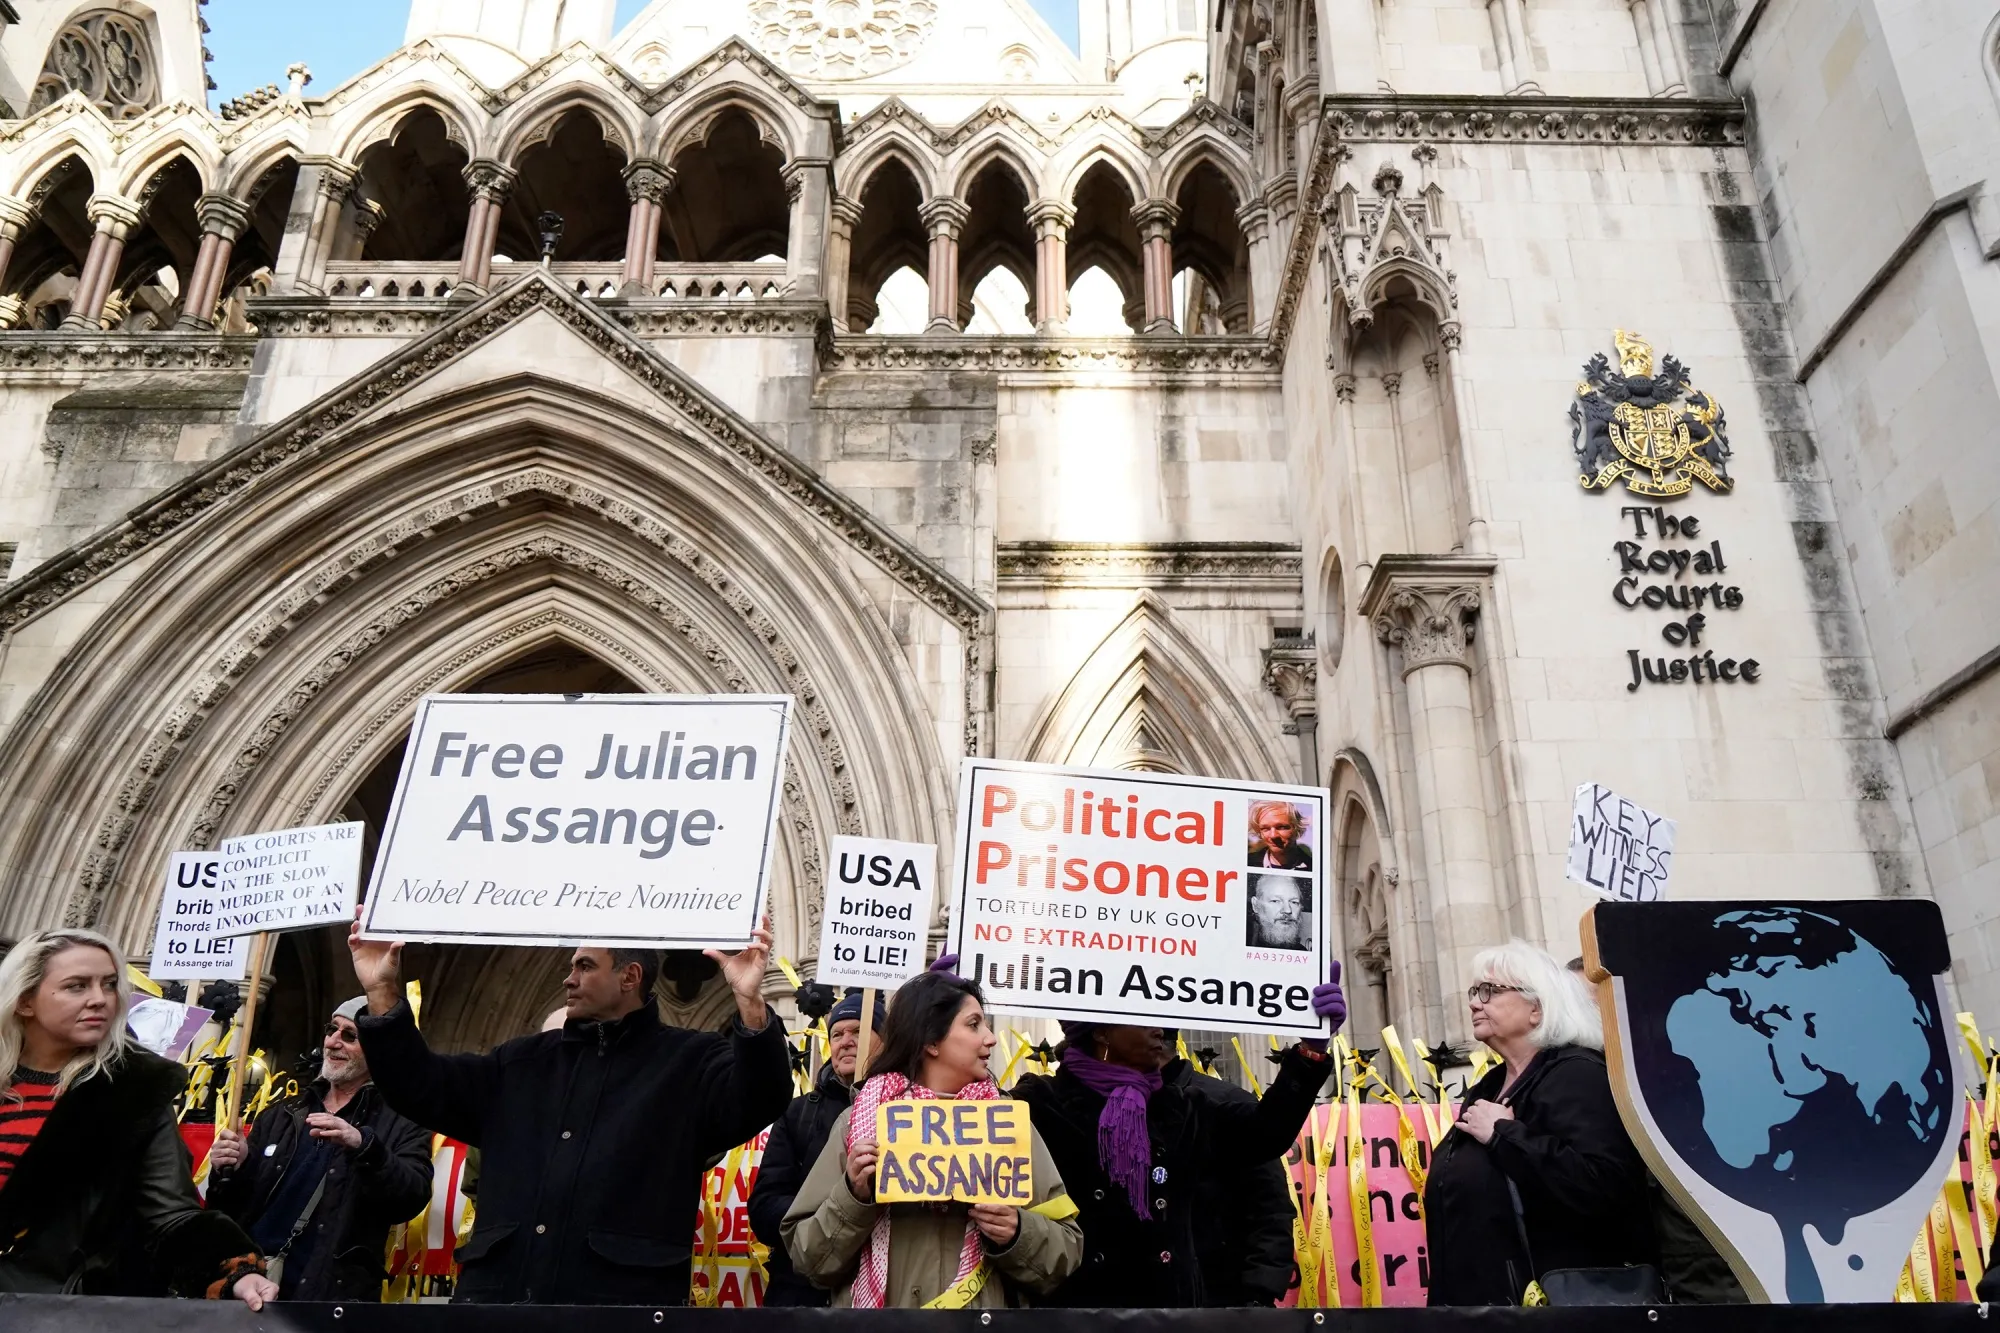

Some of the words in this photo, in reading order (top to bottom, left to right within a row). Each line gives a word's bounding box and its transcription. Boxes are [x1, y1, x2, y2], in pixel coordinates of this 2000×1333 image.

[1683, 460, 1723, 488] DROIT
[1620, 505, 1701, 539] The
[1613, 539, 1728, 580] Royal
[1612, 575, 1745, 610] Courts
[1661, 612, 1706, 646] of
[1626, 649, 1762, 692] Justice
[429, 731, 564, 780] Free
[585, 730, 758, 781] Julian
[447, 794, 716, 860] Assange
[981, 783, 1225, 847] Political
[1592, 783, 1662, 847] KEY
[226, 840, 247, 856] UK
[254, 830, 317, 851] COURTS
[323, 826, 357, 842] ARE
[1577, 814, 1672, 881] WITNESS
[177, 862, 219, 889] US
[223, 849, 312, 874] COMPLICIT
[838, 852, 921, 891] USA
[975, 839, 1239, 903] Prisoner
[1585, 847, 1658, 902] LIED
[220, 878, 237, 893] IN
[245, 871, 275, 888] THE
[282, 865, 331, 883] SLOW
[392, 878, 469, 906] Nobel
[472, 879, 549, 908] Peace
[554, 882, 622, 910] Prize
[628, 884, 743, 911] Nominee
[175, 899, 213, 915] brib
[217, 889, 285, 912] MURDER
[292, 885, 315, 900] OF
[320, 881, 345, 897] AN
[839, 896, 913, 921] bribed
[167, 921, 211, 932] Thorda
[216, 906, 297, 931] INNOCENT
[303, 901, 343, 918] MAN
[831, 921, 916, 941] Thordarson
[976, 897, 1088, 920] TORTURED
[1097, 905, 1121, 922] BY
[1130, 909, 1157, 925] UK
[1166, 911, 1222, 931] GOVT
[168, 939, 187, 955] to
[194, 938, 234, 955] LIE!
[833, 943, 856, 962] to
[863, 945, 908, 967] LIE!
[974, 923, 1013, 942] NO
[1023, 927, 1198, 957] EXTRADITION
[174, 959, 213, 970] Assange
[215, 959, 234, 968] trial
[830, 966, 838, 974] In
[839, 967, 860, 976] Julian
[861, 969, 893, 980] Assange
[894, 972, 908, 980] trial
[1246, 951, 1309, 964] #A9379AY
[972, 952, 1104, 997] Julian
[1119, 964, 1310, 1018] Assange
[885, 1104, 1017, 1146] FREE
[878, 1149, 1031, 1199] ASSANGE
[1357, 1193, 1371, 1232] Gerber
